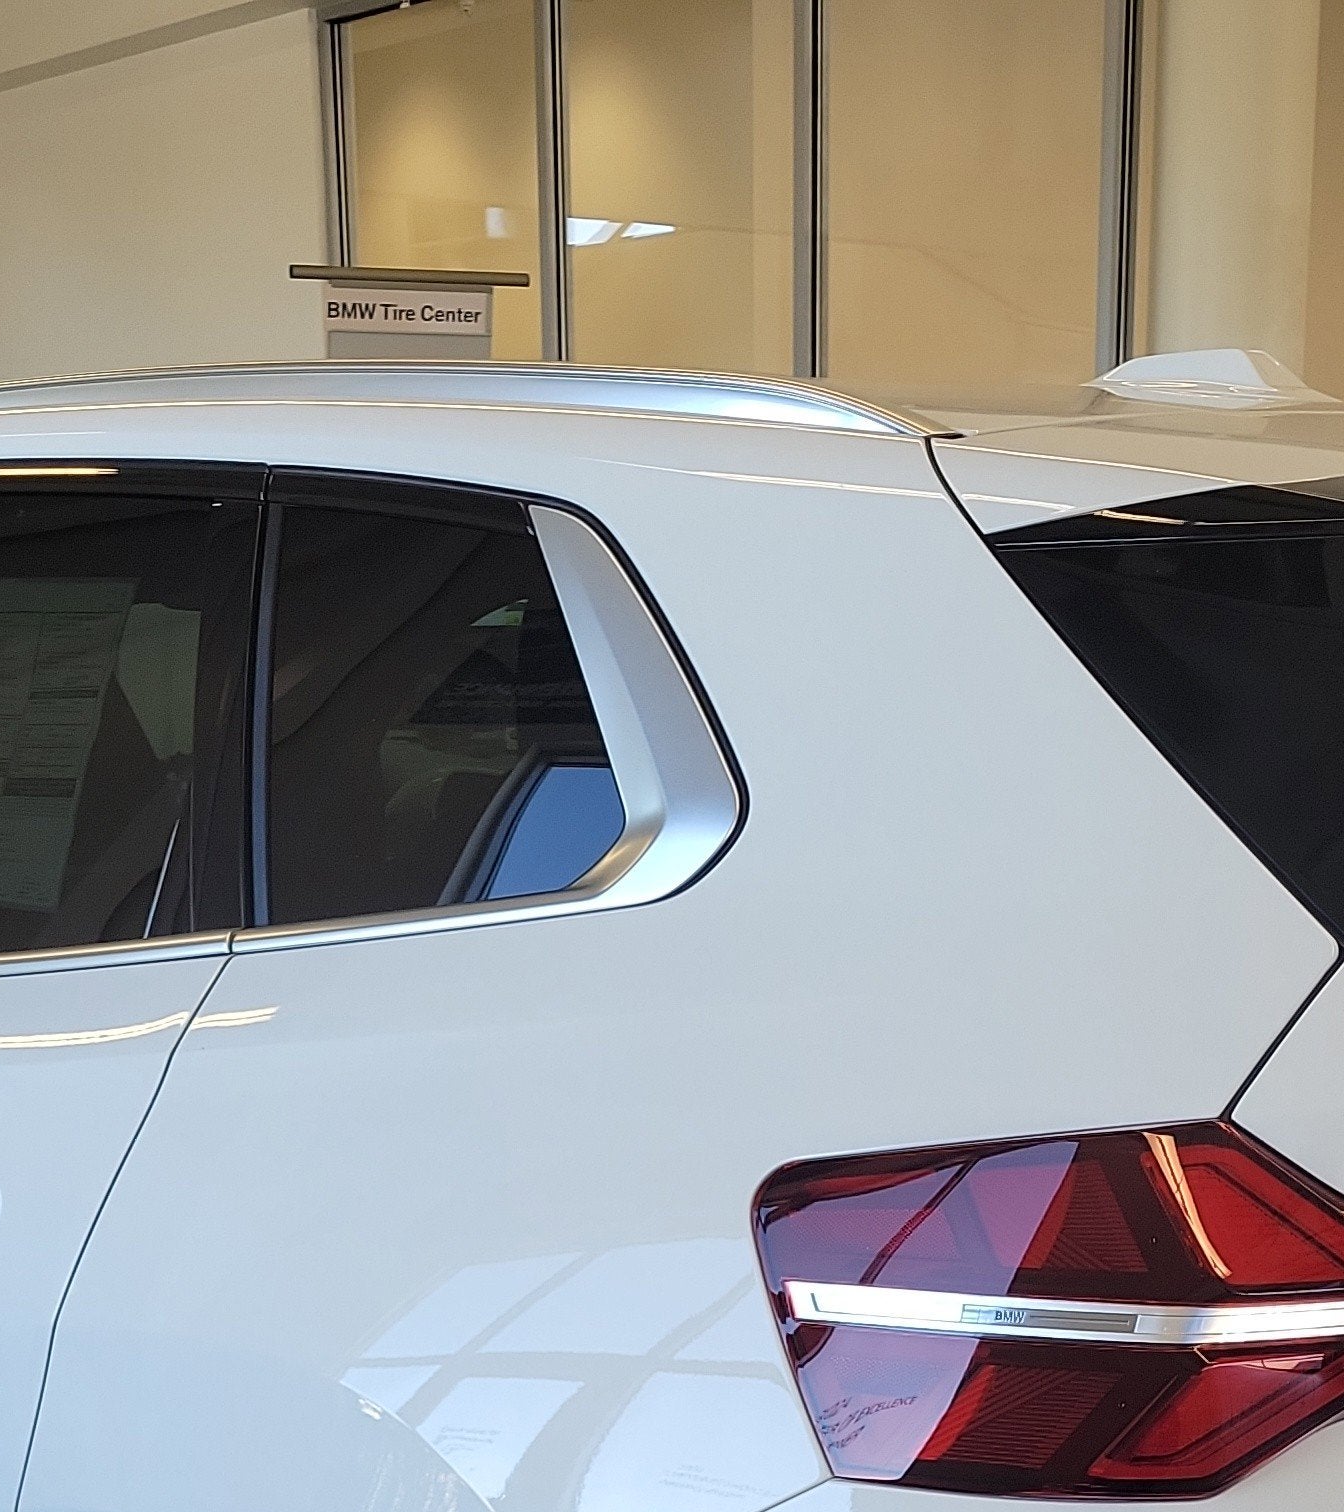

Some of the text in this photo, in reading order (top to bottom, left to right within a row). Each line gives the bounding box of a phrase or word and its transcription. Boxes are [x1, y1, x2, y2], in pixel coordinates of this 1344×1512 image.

[327, 301, 482, 323] BMW Tire Center
[994, 1309, 1025, 1323] BMW
